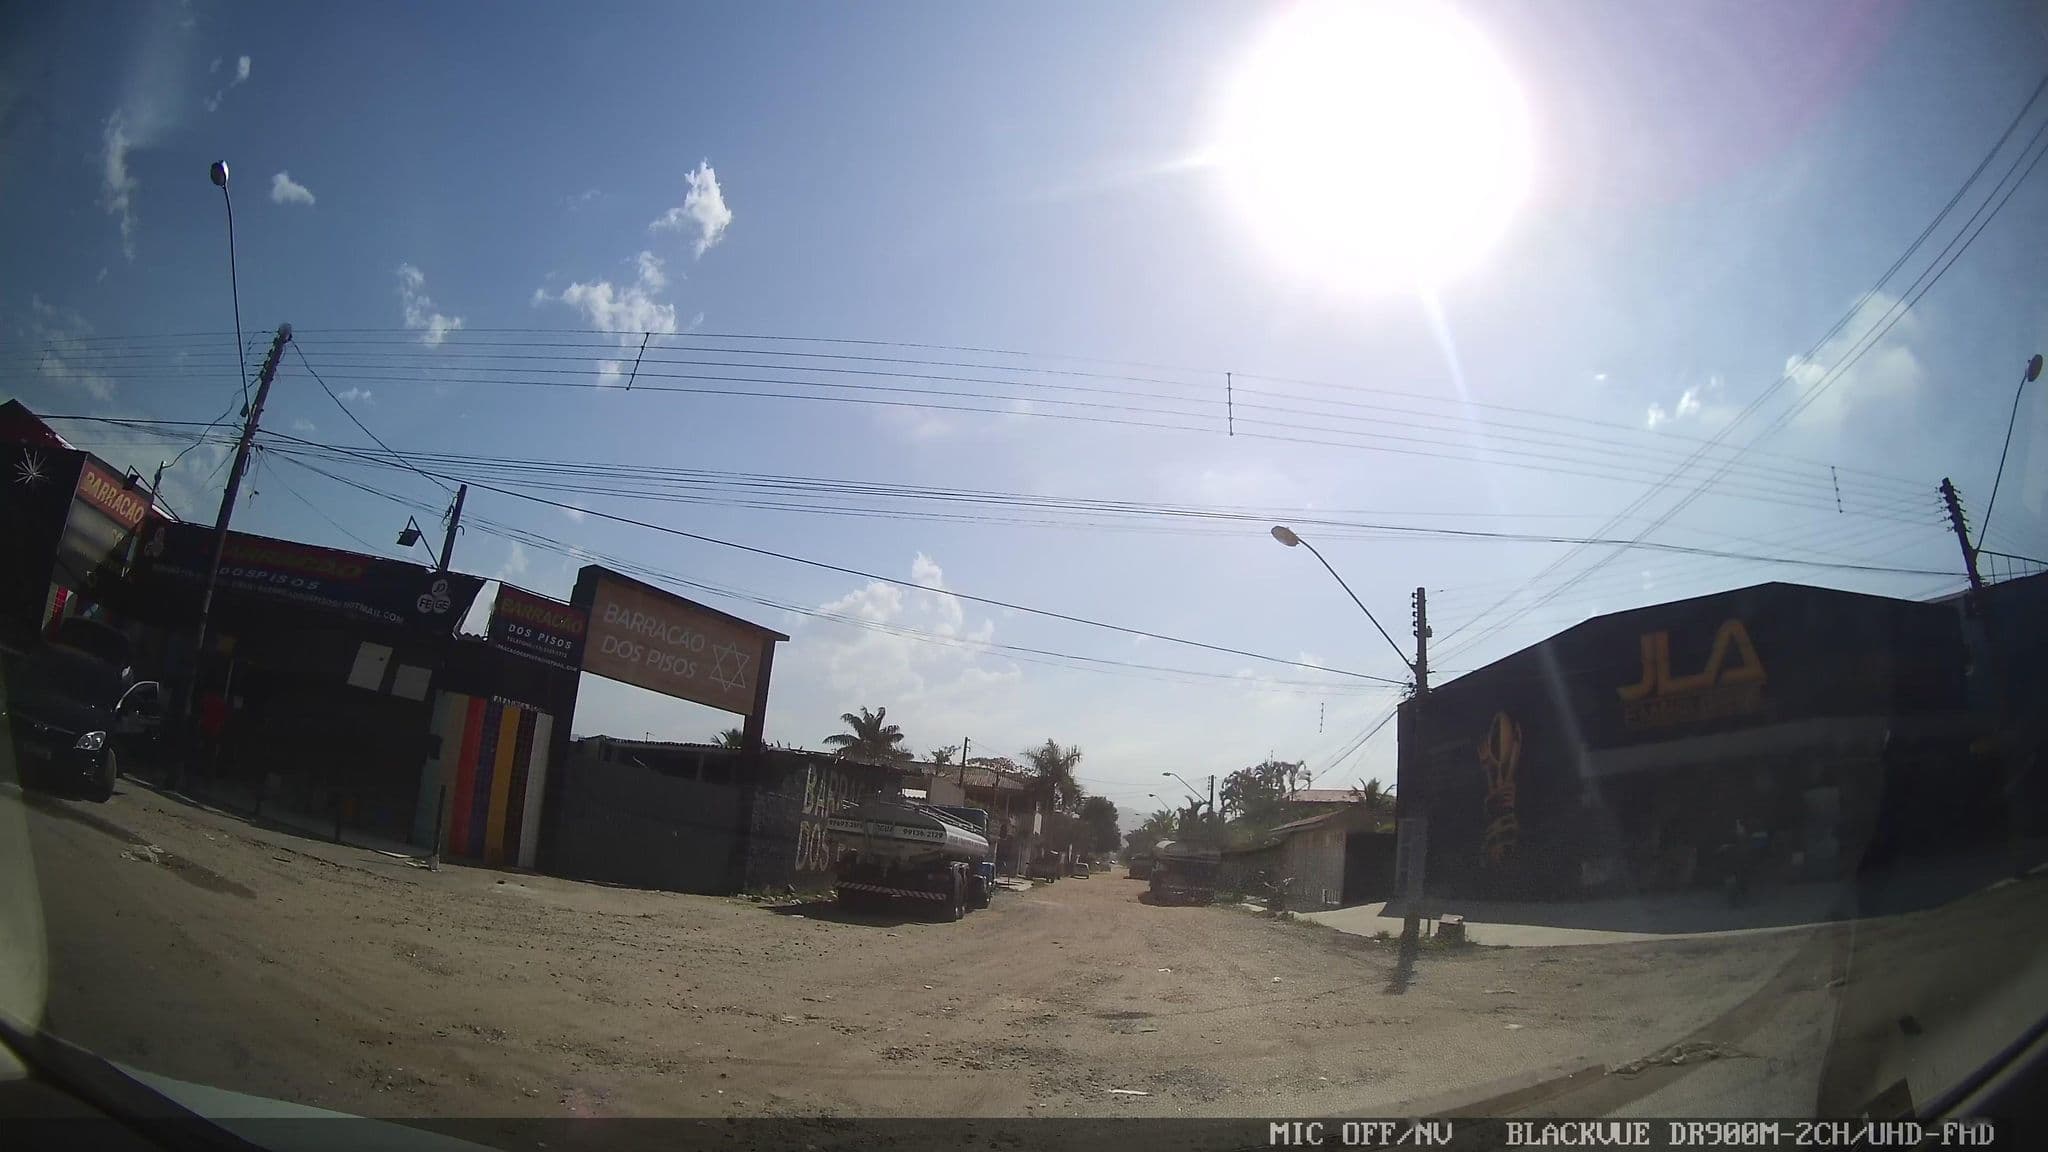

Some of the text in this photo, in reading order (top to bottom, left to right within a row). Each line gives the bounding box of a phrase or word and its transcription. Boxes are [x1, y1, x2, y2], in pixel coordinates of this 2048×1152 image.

[508, 624, 572, 650] DOS PISOS
[601, 634, 645, 664] DOS
[645, 649, 699, 680] PISOS
[1616, 617, 1768, 701] JLA
